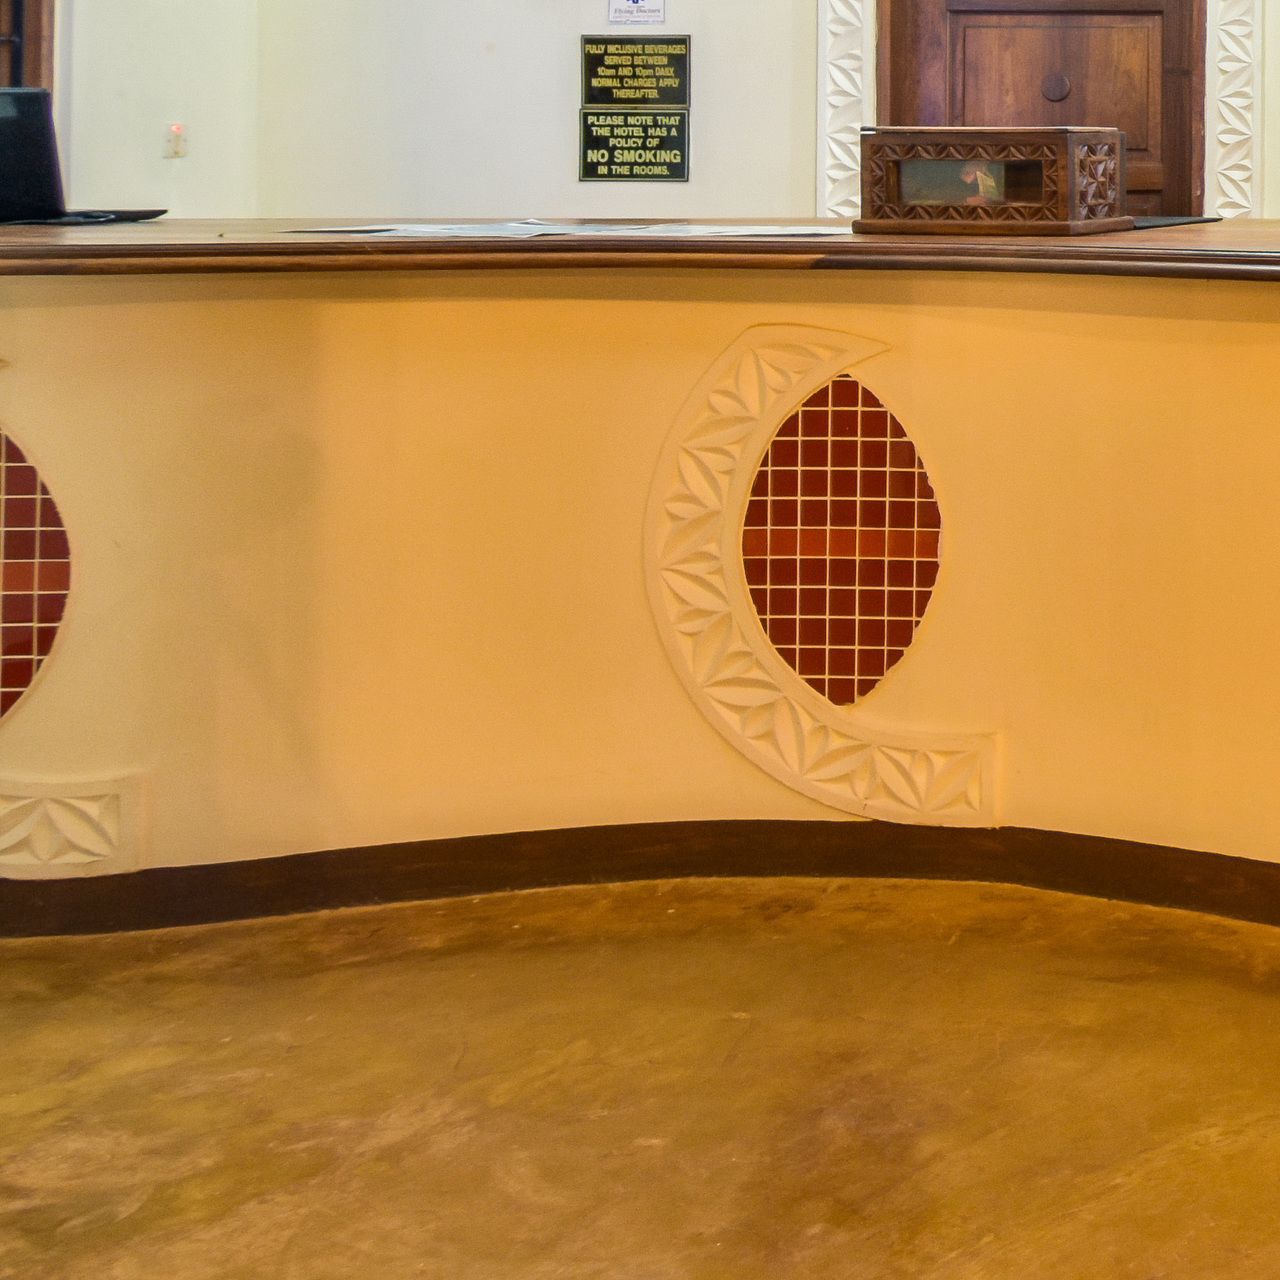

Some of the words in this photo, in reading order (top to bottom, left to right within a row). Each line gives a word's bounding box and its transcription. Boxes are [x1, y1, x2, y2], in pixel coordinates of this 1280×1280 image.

[585, 45, 605, 53] FULLY
[607, 45, 642, 53] INCLUSIVE
[645, 45, 686, 53] BEVERAGES
[604, 56, 631, 64] SERVED
[634, 56, 667, 64] BETWEEN
[618, 67, 633, 75] AND
[636, 67, 653, 76] 10pm
[592, 79, 621, 87] NORMAL
[624, 79, 656, 87] CHARGES
[659, 79, 679, 87] APPLY
[588, 116, 624, 125] PLEASE
[627, 116, 653, 125] NOTE
[656, 116, 680, 125] THAT
[592, 127, 610, 136] THE
[614, 127, 645, 136] HOTEL
[648, 127, 667, 136] HAS
[670, 127, 677, 136] A
[609, 138, 643, 147] POLICY
[647, 138, 659, 147] OF
[587, 150, 608, 162] NO
[614, 150, 681, 162] SMOKING
[598, 166, 607, 174] IN
[611, 166, 630, 174] THE
[633, 166, 669, 174] ROOMS.
